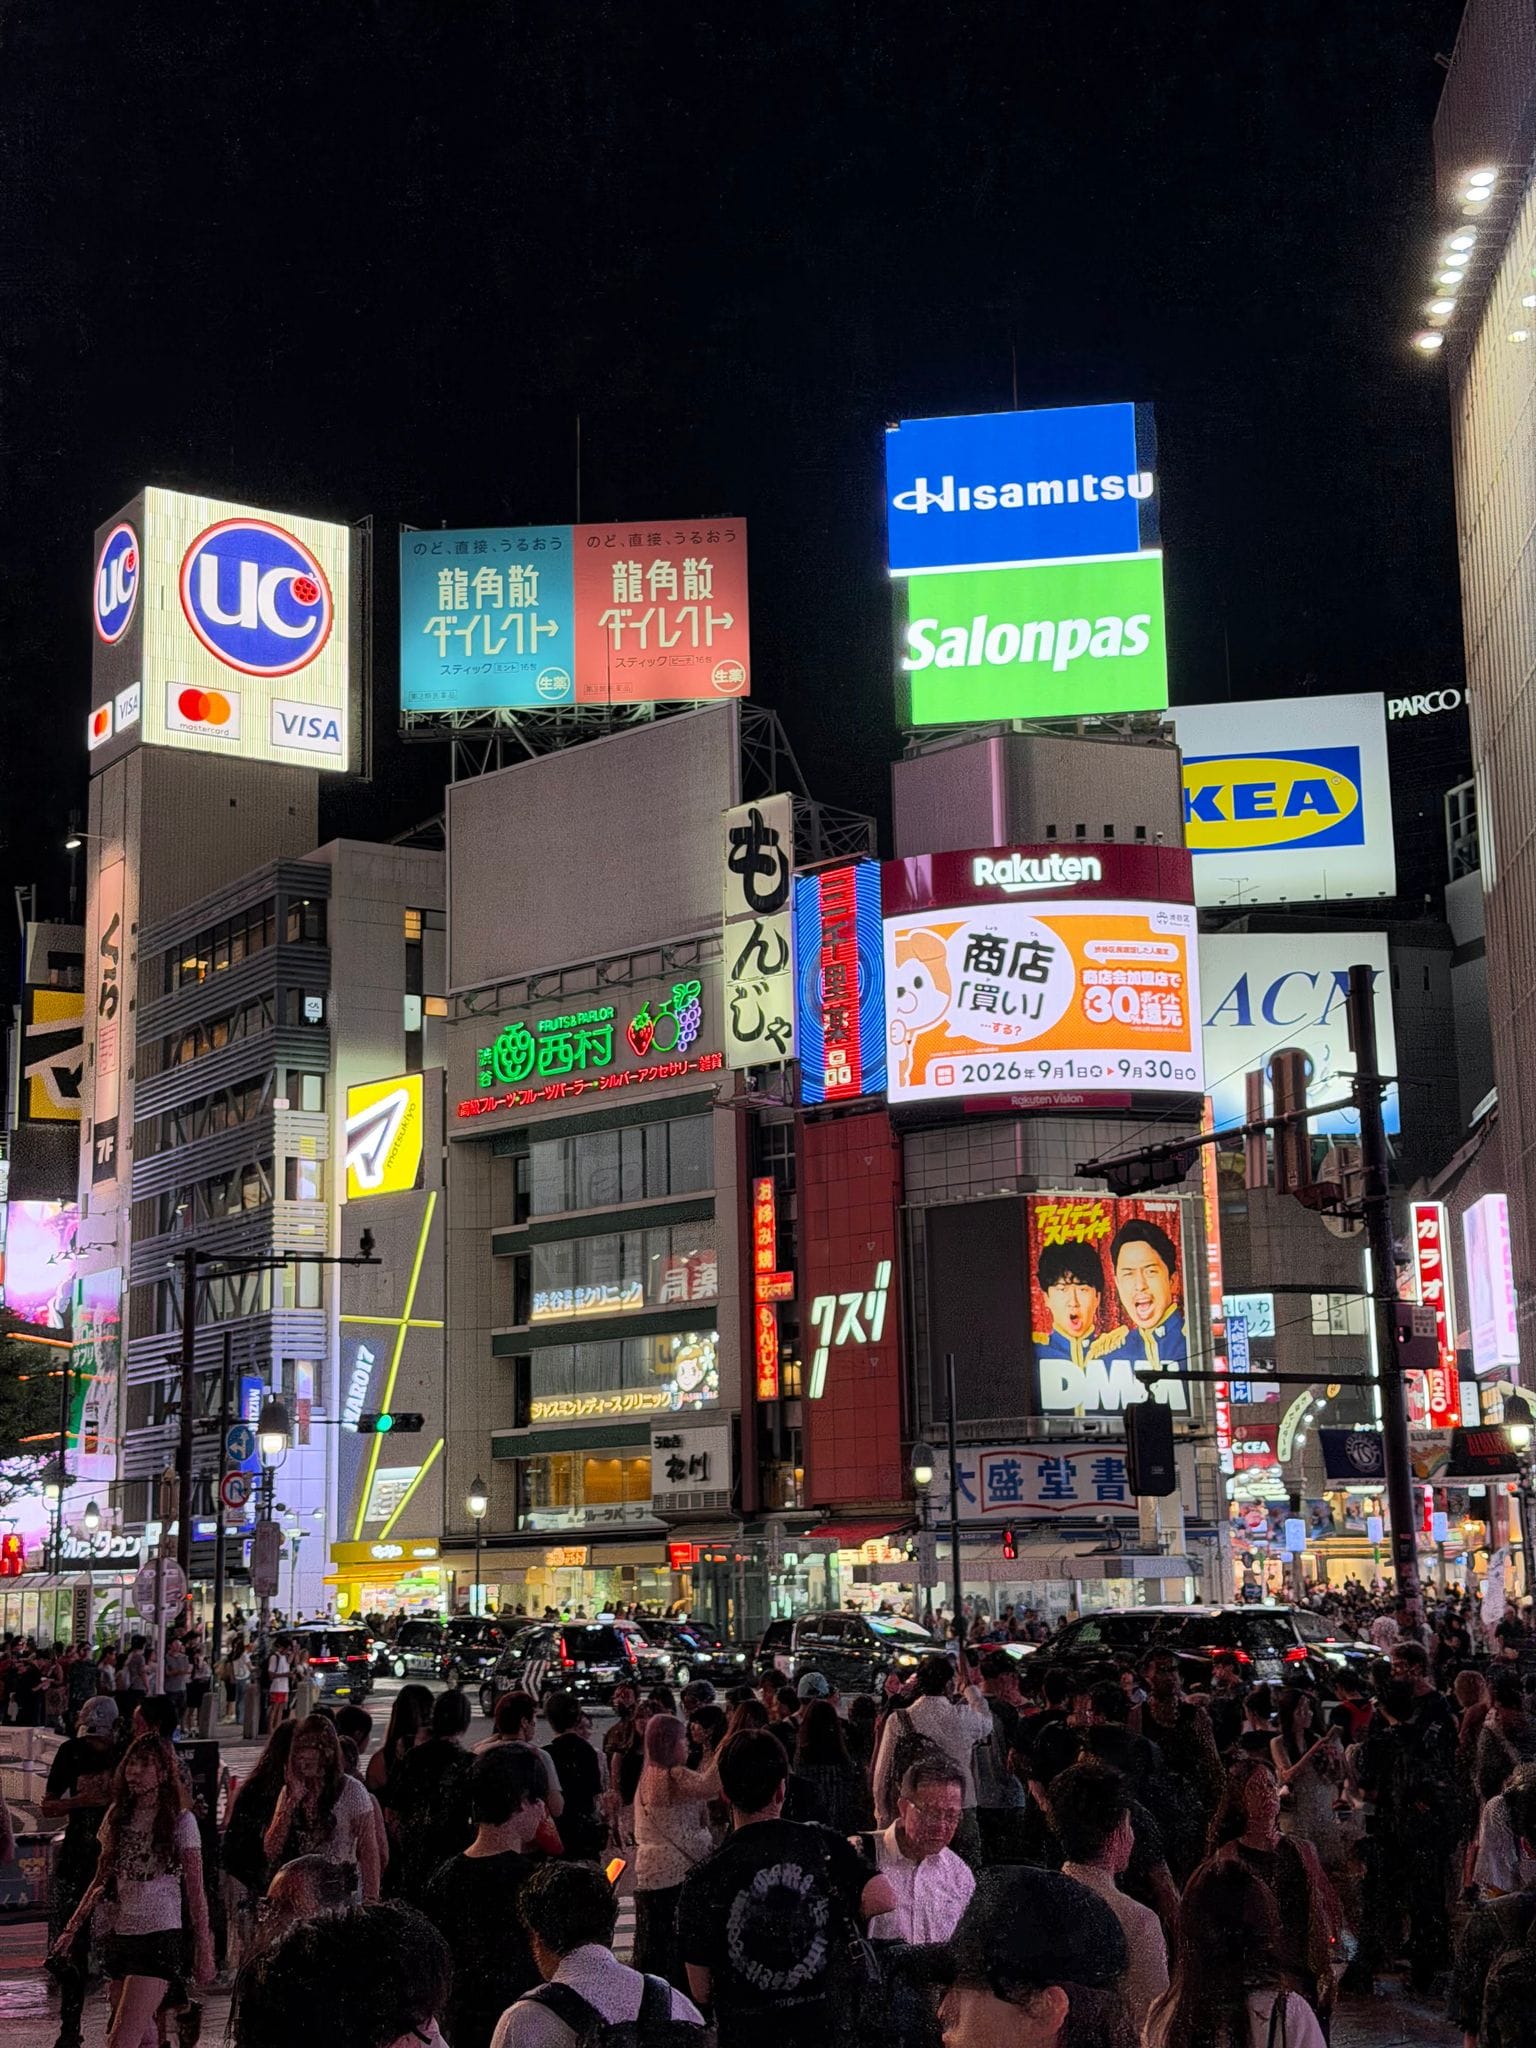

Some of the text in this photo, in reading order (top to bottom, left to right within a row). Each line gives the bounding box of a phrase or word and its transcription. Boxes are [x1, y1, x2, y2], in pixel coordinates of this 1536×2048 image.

[893, 472, 1154, 514] Hisamitsu
[413, 536, 562, 556] のど、直接、うるおう
[587, 529, 737, 549] のど、直接、うるおう
[438, 564, 540, 611] 龍角散
[612, 557, 714, 604] 龍角散
[423, 612, 559, 658] ダイレクト
[598, 605, 735, 651] ダイレクト
[902, 614, 1151, 672] Salonpas
[440, 663, 493, 676] スティック
[615, 655, 668, 668] スティック
[713, 669, 743, 684] 生薬
[539, 677, 569, 691] 生薬
[1388, 688, 1460, 720] PARCO
[119, 694, 138, 720] VISA
[275, 711, 340, 743] VISA
[179, 722, 230, 736] mastercard
[1184, 778, 1341, 824] KEA
[972, 852, 1102, 887] Rakuten
[728, 807, 793, 1055] もんじゃ
[963, 930, 1056, 985] 商店
[957, 979, 1046, 1021] 「買い」
[1142, 1002, 1184, 1027] 還元
[478, 1047, 493, 1088] 渋谷
[537, 1023, 614, 1078] 西村
[1011, 1093, 1084, 1106] Rakuten Vision
[96, 1134, 115, 1165] 7F
[1417, 1218, 1447, 1326] カラオ
[810, 1260, 892, 1398] クスリ
[1430, 1369, 1447, 1413] ECHO
[945, 1456, 1129, 1504] 大盛堂書
[76, 1588, 88, 1644] SMOKIN
